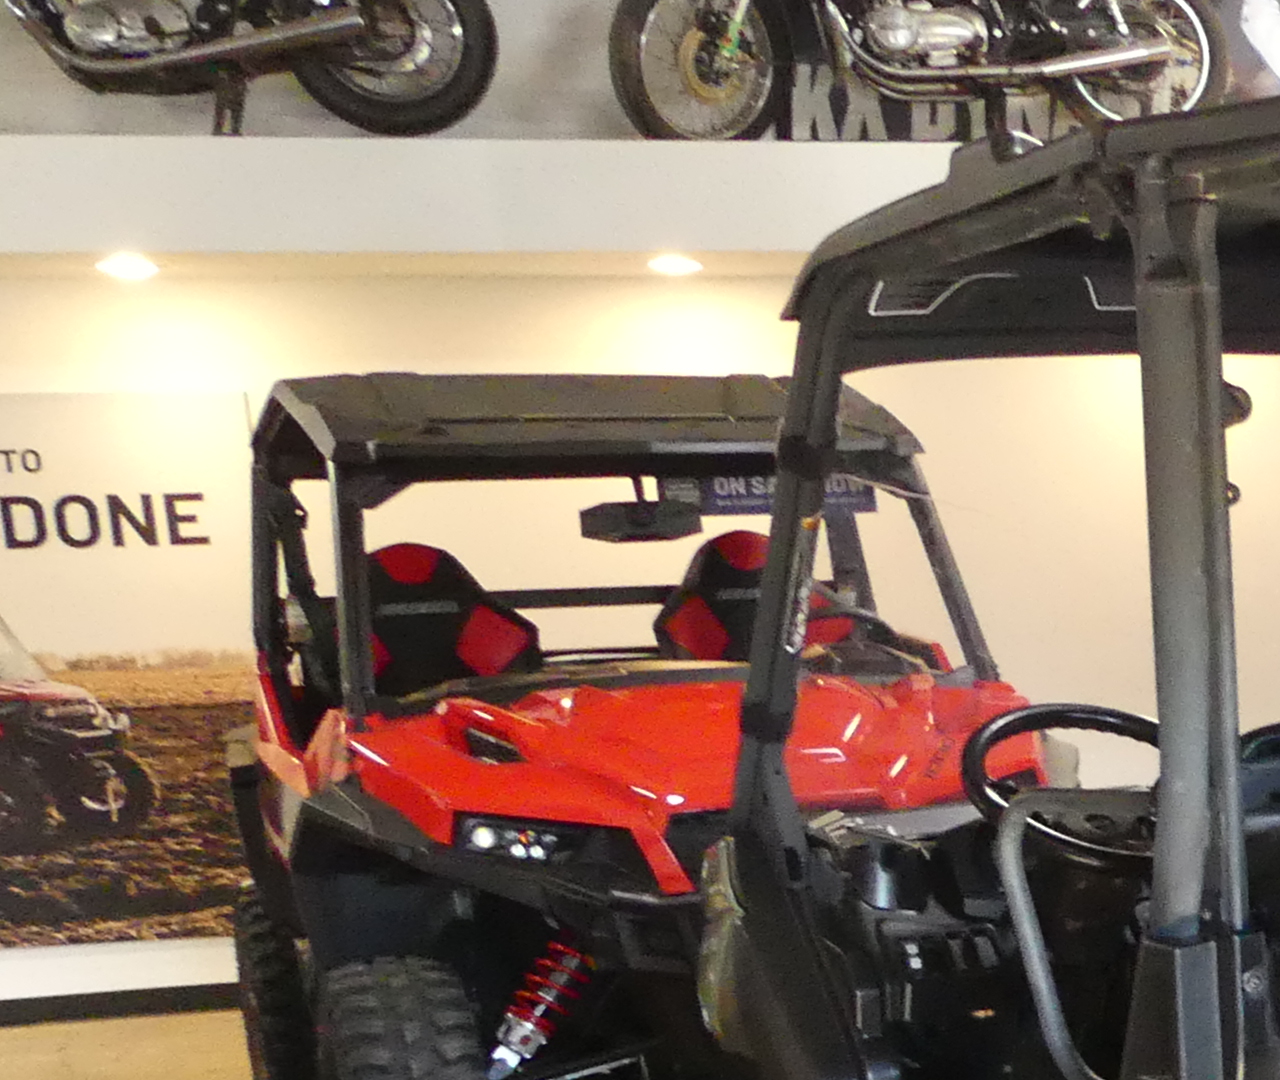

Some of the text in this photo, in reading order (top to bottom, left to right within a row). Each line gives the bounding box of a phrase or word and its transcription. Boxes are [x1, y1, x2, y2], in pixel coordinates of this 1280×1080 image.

[0, 449, 42, 473] TO
[713, 476, 747, 496] ON
[0, 493, 210, 549] DONE
